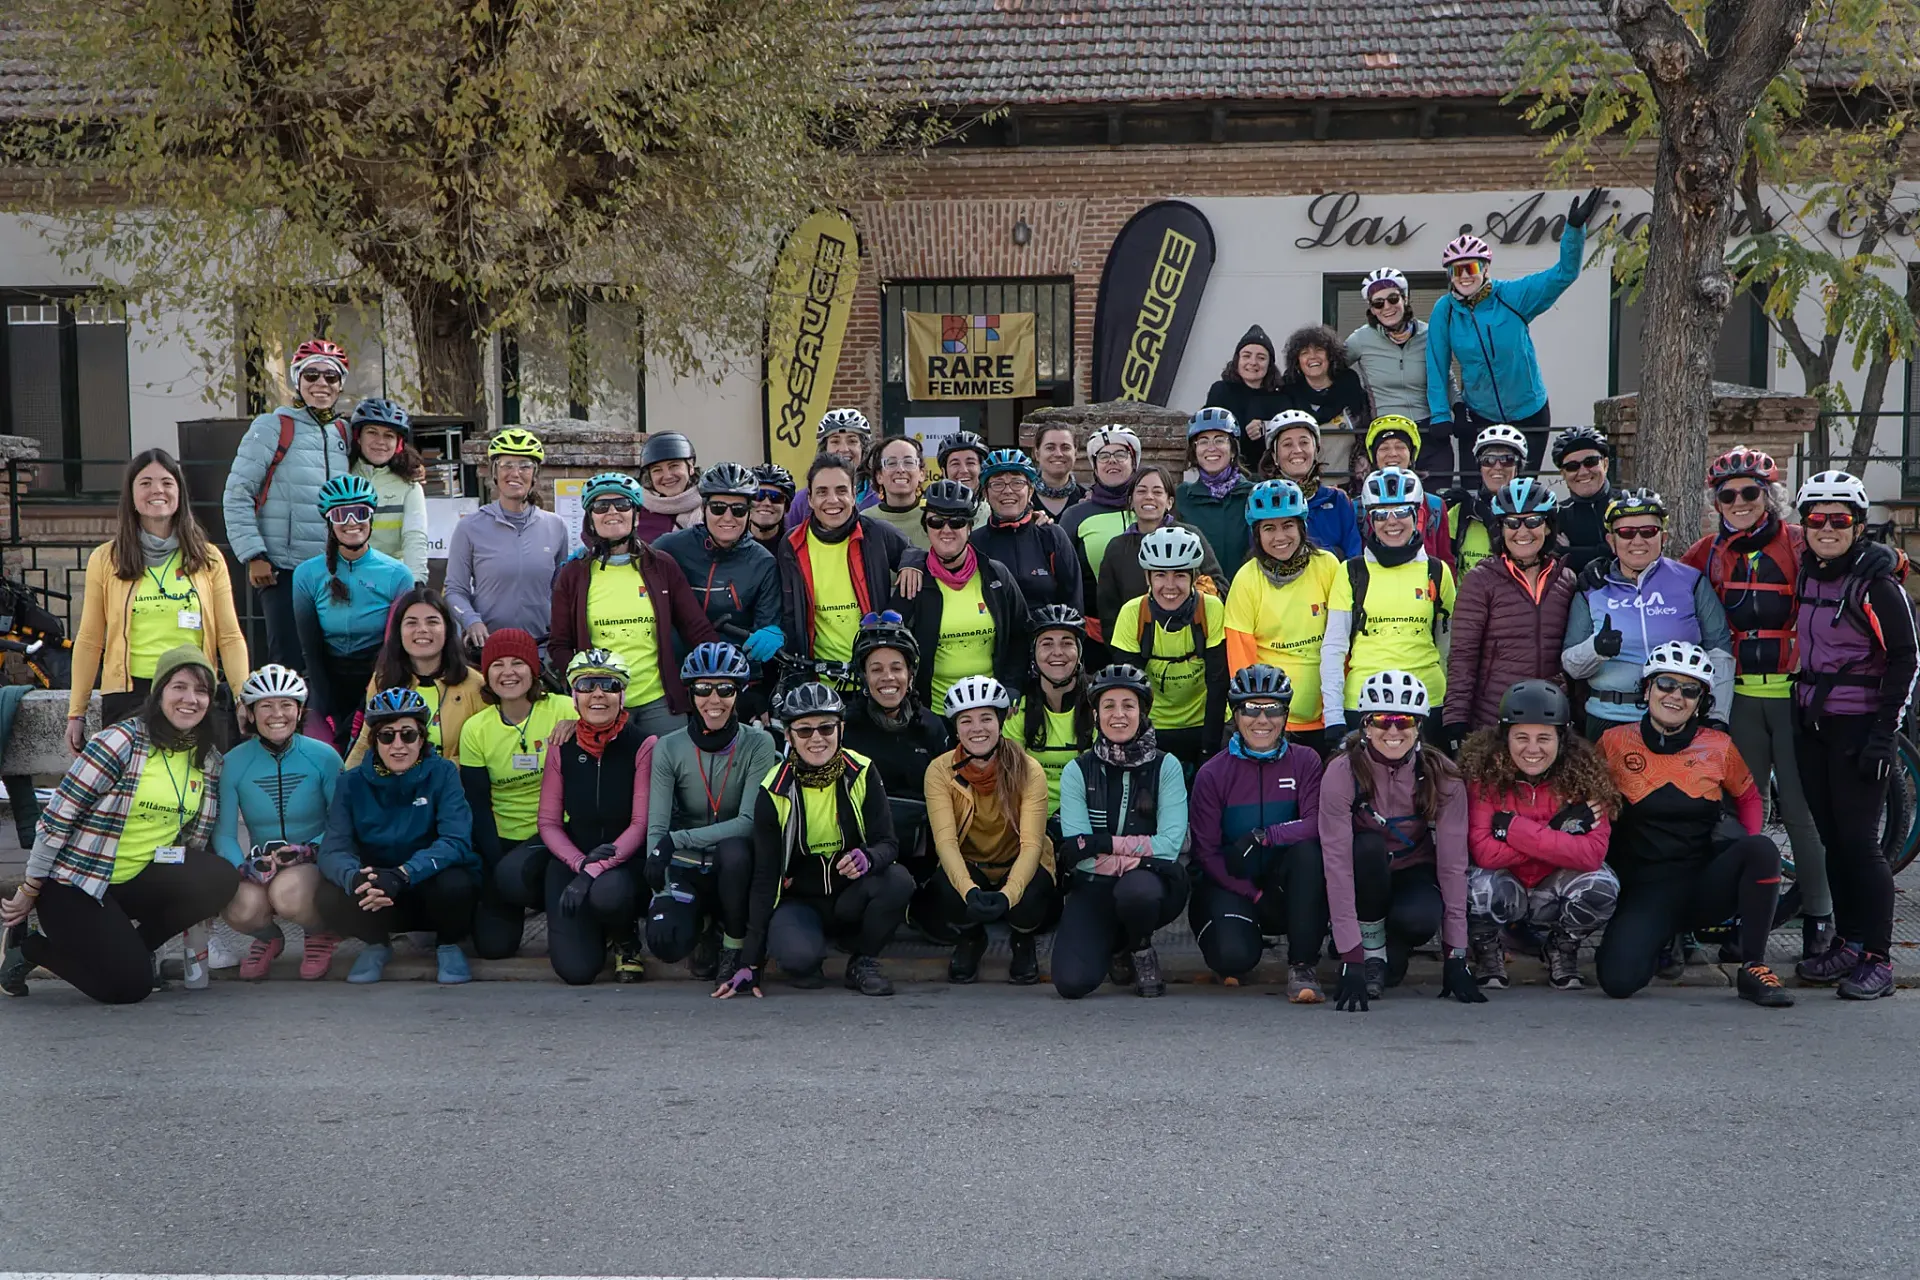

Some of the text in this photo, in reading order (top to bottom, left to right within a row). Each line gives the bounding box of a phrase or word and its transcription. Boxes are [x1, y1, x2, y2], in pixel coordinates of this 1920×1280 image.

[1295, 191, 1427, 249] Las
[1117, 228, 1197, 402] SAUCE
[928, 355, 1014, 379] RARE
[928, 381, 1014, 395] FEMMES
[1646, 606, 1677, 616] bikes
